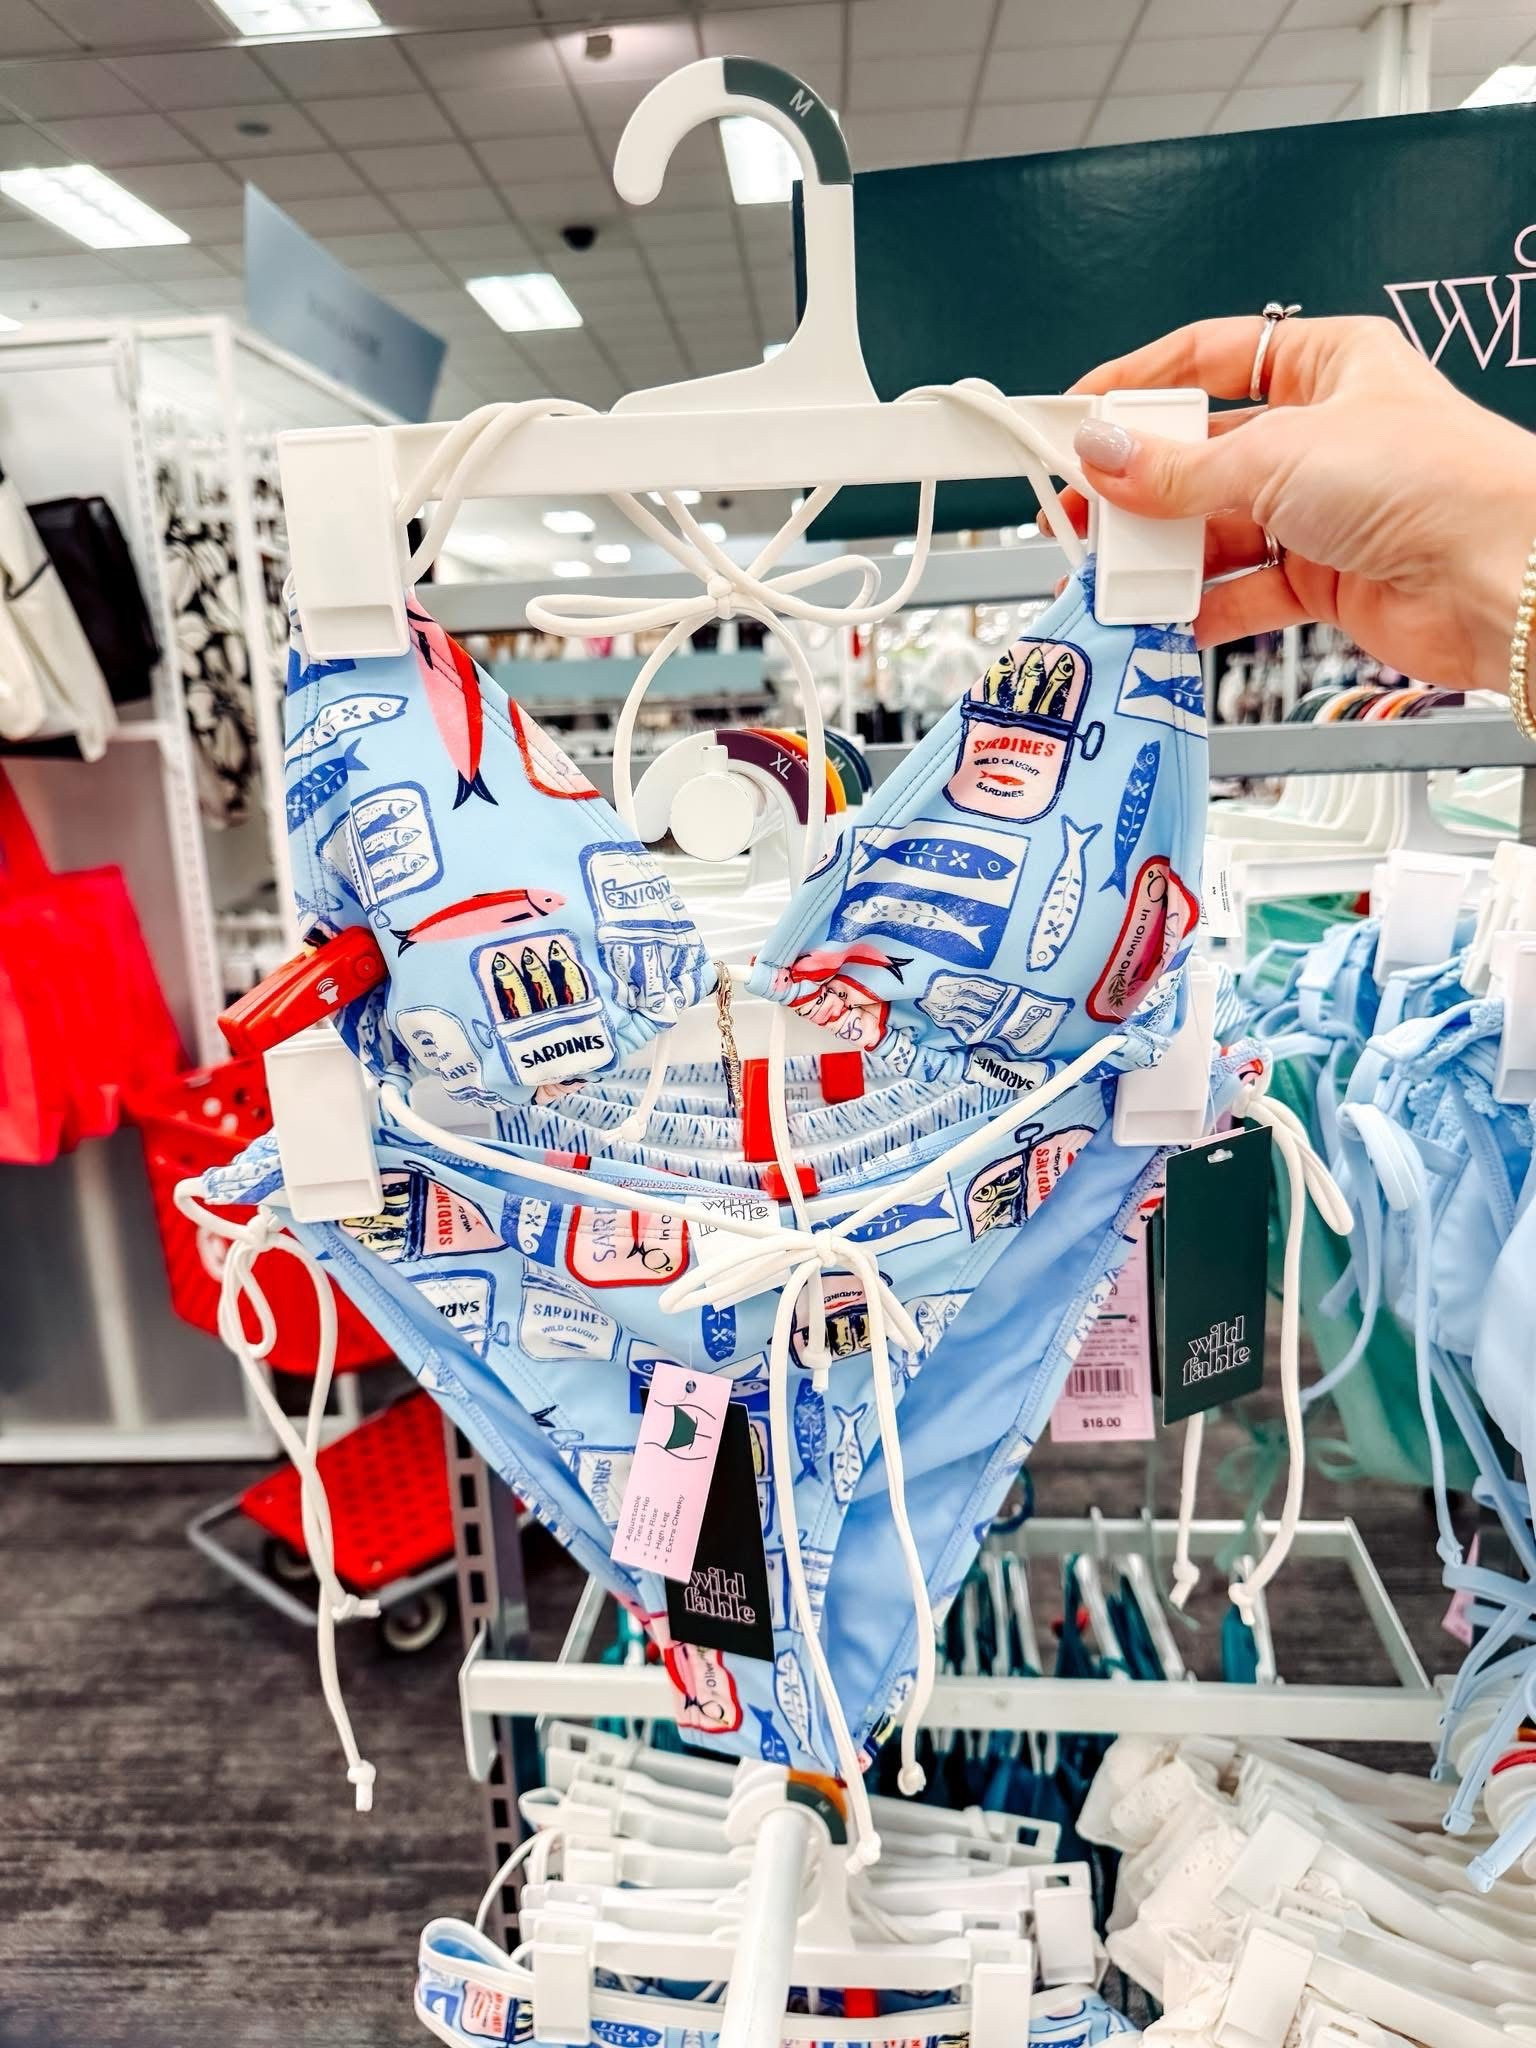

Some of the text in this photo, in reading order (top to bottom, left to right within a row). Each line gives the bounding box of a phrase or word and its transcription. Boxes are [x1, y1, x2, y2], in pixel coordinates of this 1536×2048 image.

[789, 88, 815, 118] M
[973, 736, 1057, 757] SARDINES
[768, 752, 793, 780] XL
[976, 781, 1025, 798] SARDINES
[1140, 909, 1151, 921] In
[520, 1035, 605, 1069] SARDINES
[533, 1303, 609, 1327] SARDINES
[541, 1324, 600, 1343] WILD CAUGHT
[1188, 1315, 1245, 1356] wild
[1182, 1343, 1251, 1386] fable
[1081, 1416, 1122, 1429] $18.00
[625, 1495, 642, 1541] Adjustable
[642, 1496, 651, 1512] Hip
[645, 1508, 659, 1547] Low Rise
[656, 1512, 670, 1550] High Leg
[665, 1494, 686, 1553] Extra Cheeky
[689, 1566, 747, 1600] wild
[684, 1586, 756, 1625] fable
